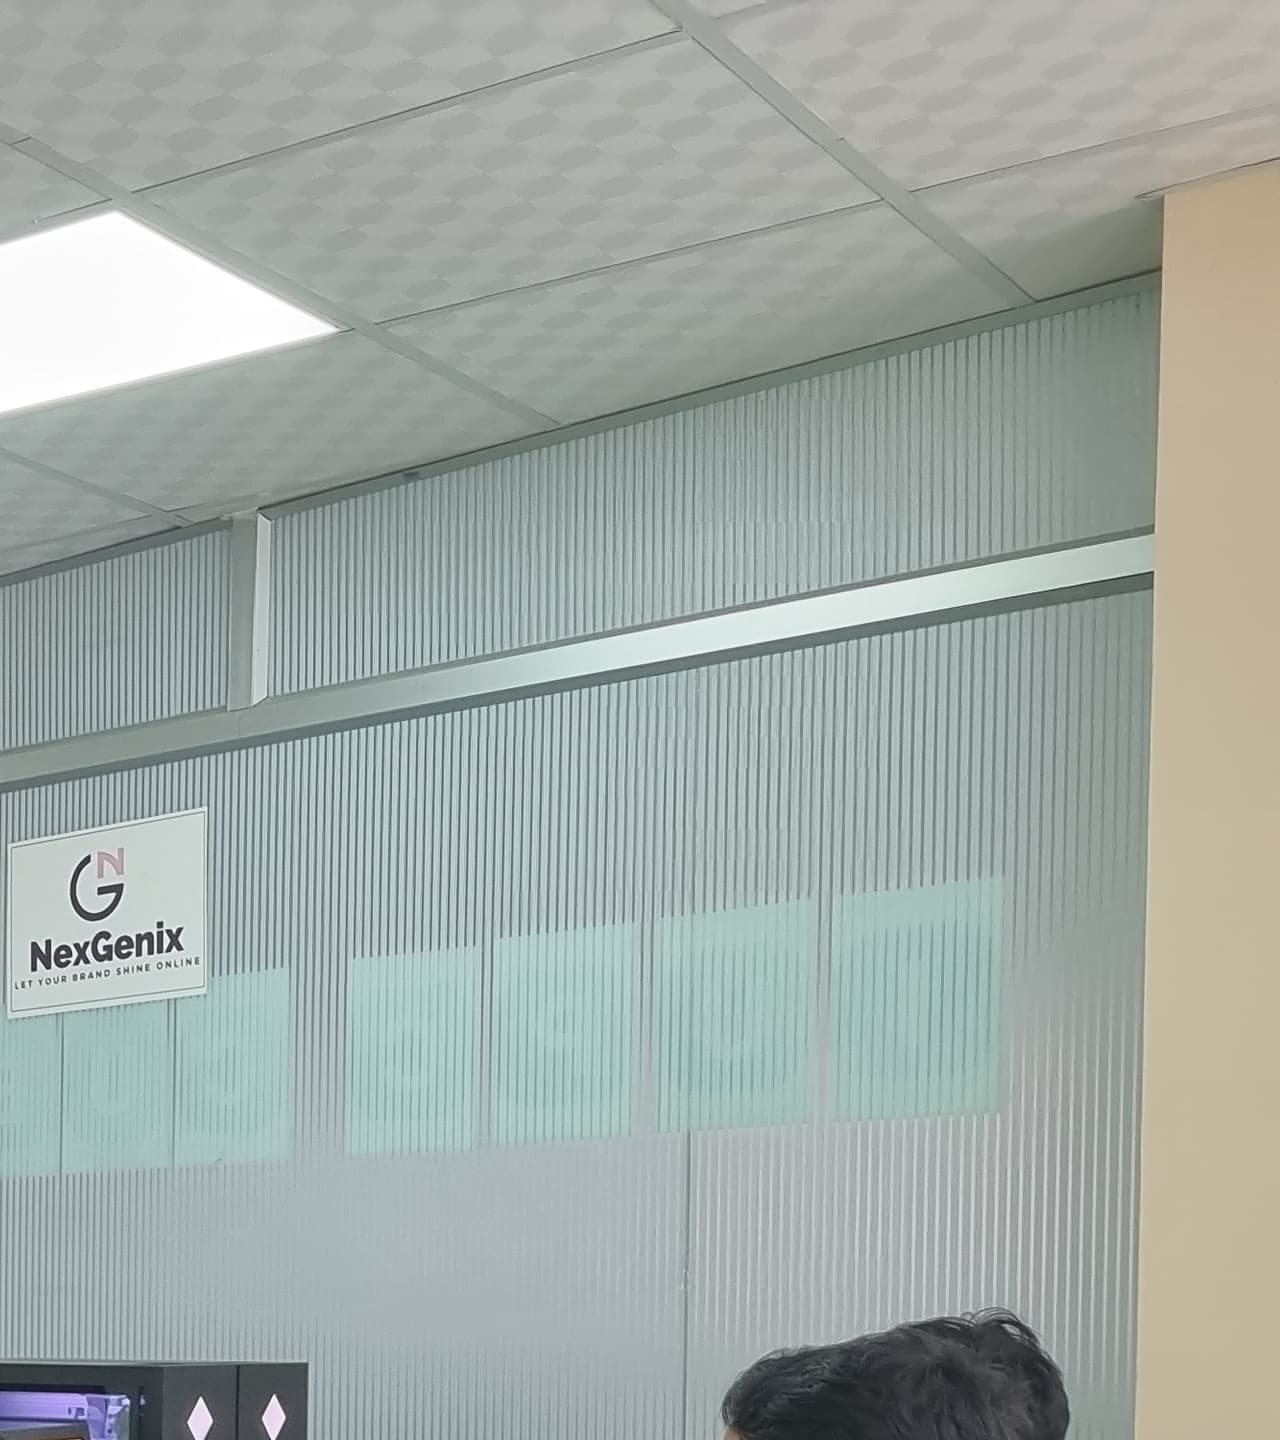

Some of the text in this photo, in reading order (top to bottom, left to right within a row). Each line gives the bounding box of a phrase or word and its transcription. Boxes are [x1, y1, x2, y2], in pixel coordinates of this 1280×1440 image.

[30, 920, 184, 973] NexGenix
[14, 956, 201, 990] LET YOUR BRAND SHINE ONLINE
